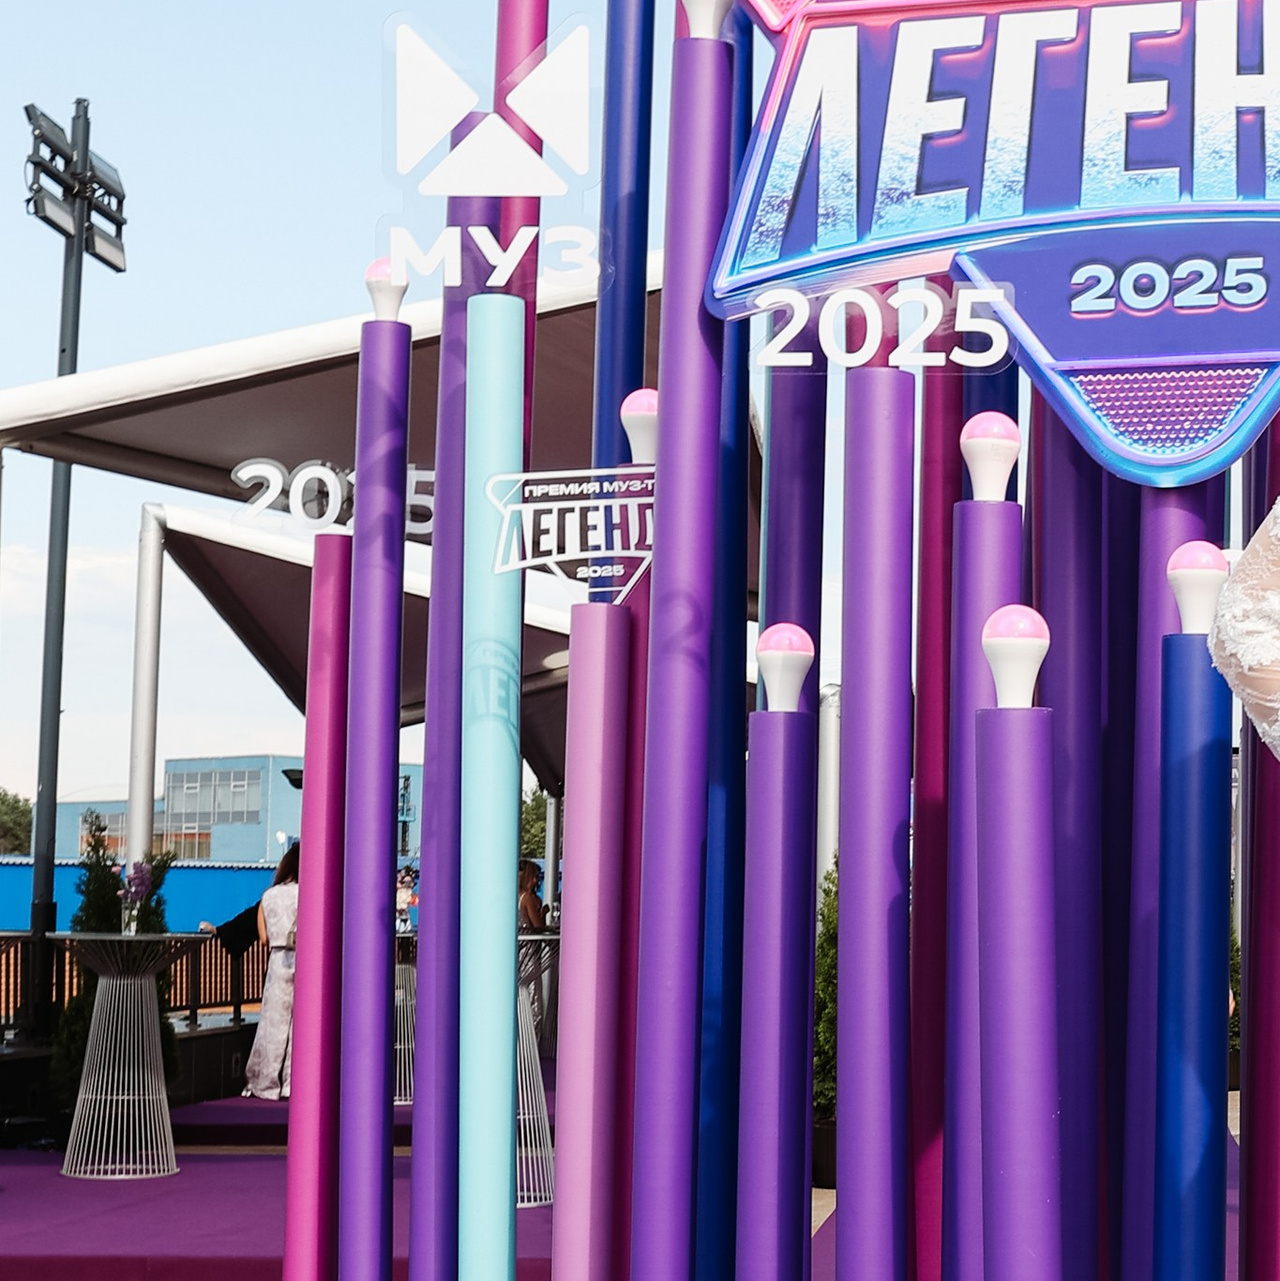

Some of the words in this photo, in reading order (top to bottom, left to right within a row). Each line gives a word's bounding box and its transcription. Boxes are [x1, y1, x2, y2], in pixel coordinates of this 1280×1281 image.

[390, 225, 600, 287] МУЗ
[1070, 257, 1267, 312] 2025
[753, 287, 1010, 368] 2025
[237, 463, 435, 534] 205
[524, 482, 600, 497] ПРЕМИЯ
[602, 479, 655, 494] МУЗ-Т
[501, 503, 654, 567] ЛЕГЕНД
[576, 565, 625, 578] 2025
